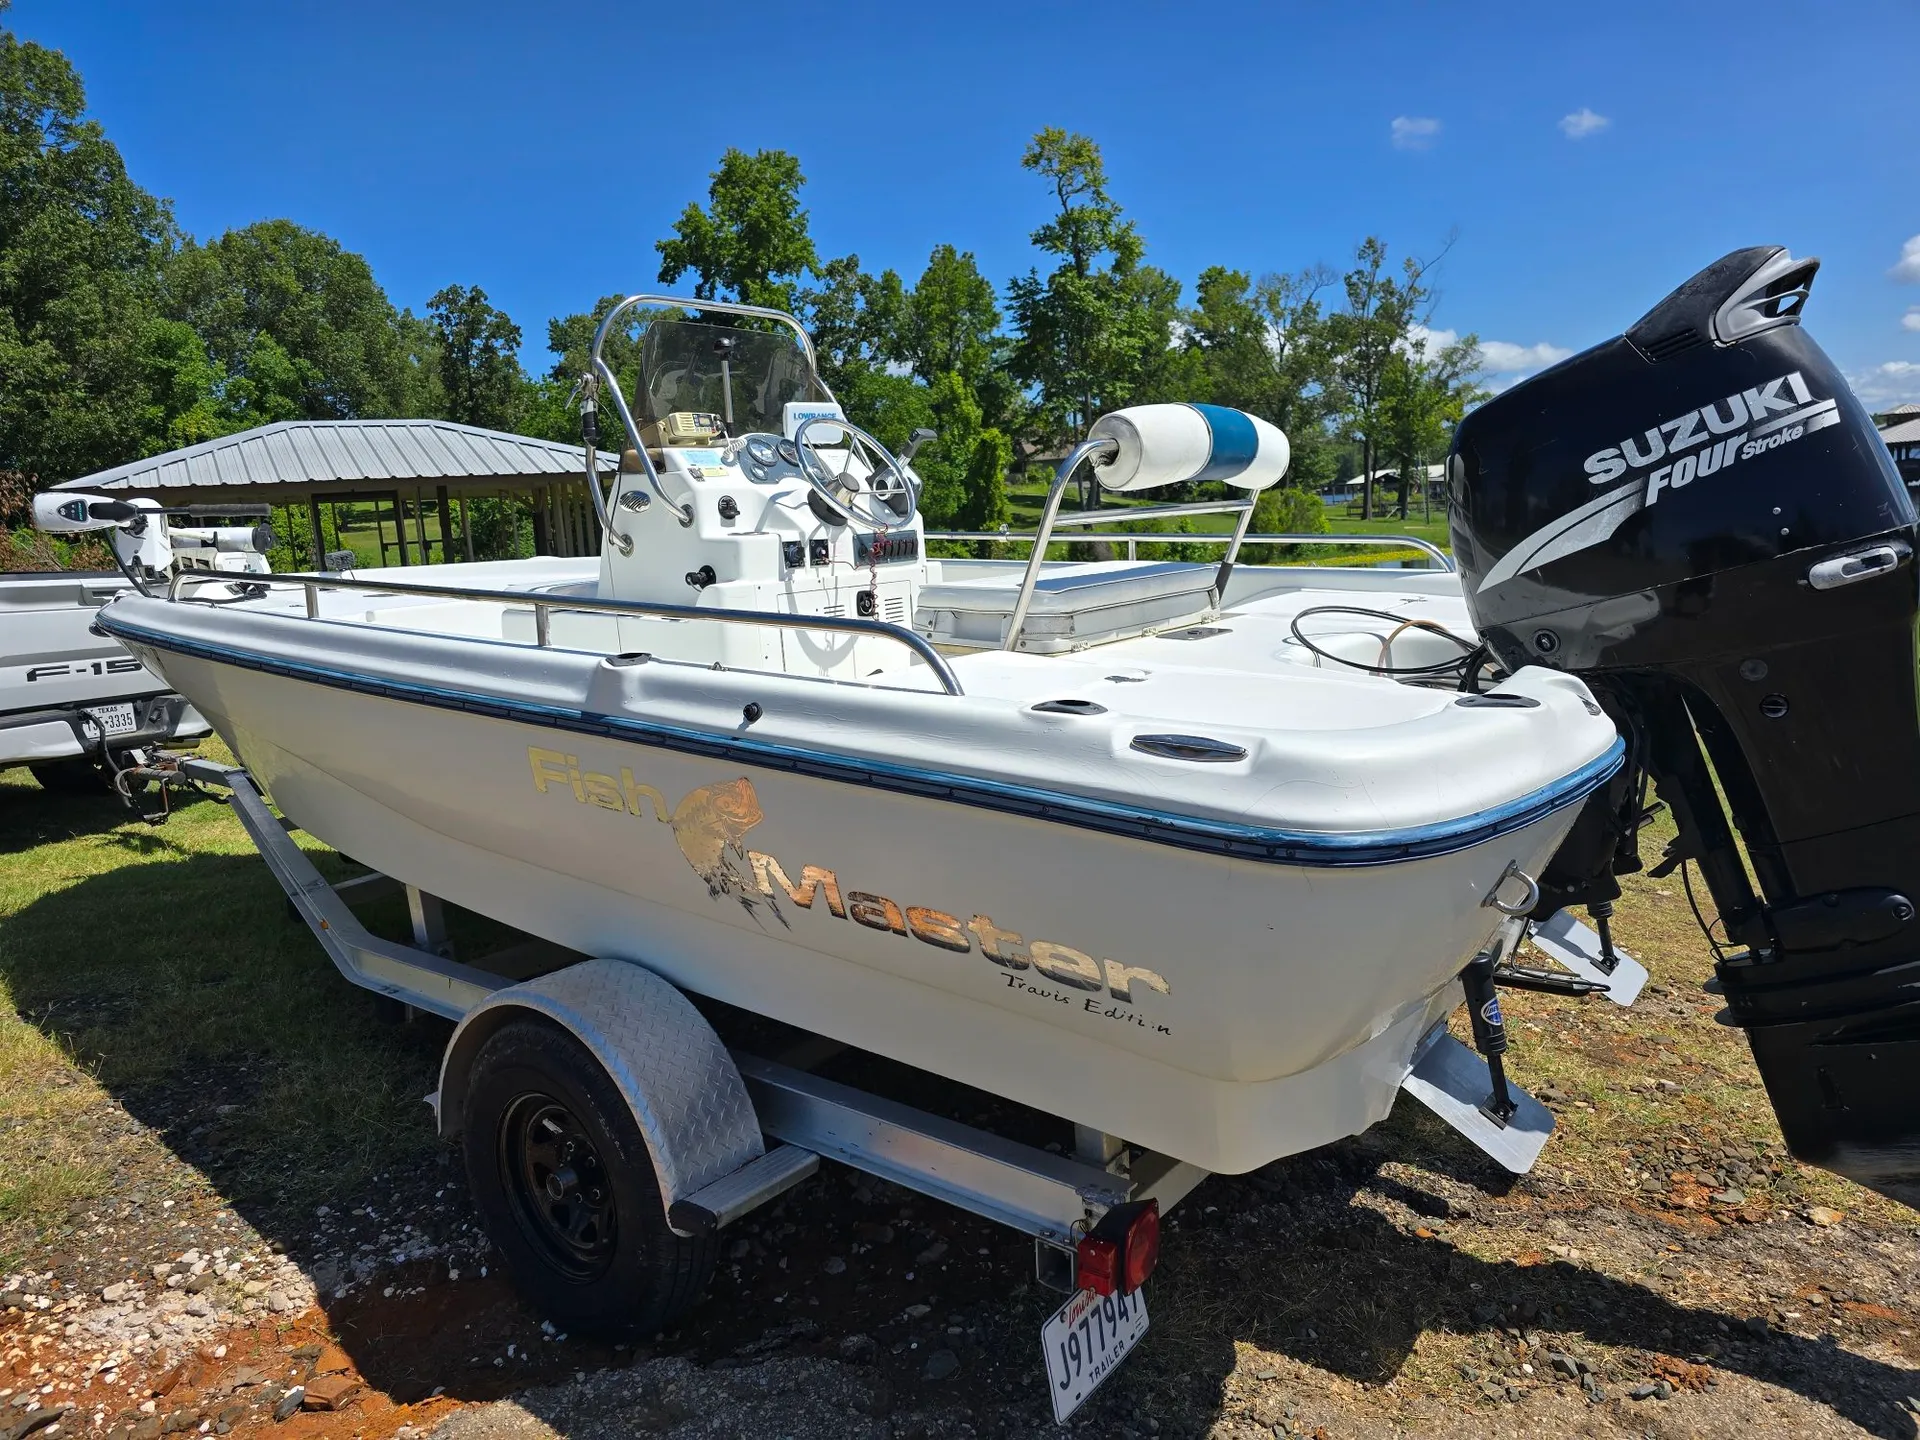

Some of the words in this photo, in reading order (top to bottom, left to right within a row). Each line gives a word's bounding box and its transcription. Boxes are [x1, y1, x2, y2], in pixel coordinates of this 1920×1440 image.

[793, 412, 837, 420] LOWRANCE
[1583, 371, 1812, 485] SUZUKI
[1741, 425, 1803, 460] Stroke
[26, 659, 142, 682] F-15
[98, 706, 118, 714] TEXAS
[527, 745, 672, 824] Fish
[747, 849, 1172, 1004] Master
[1001, 972, 1071, 1004] Travis
[1084, 998, 1172, 1036] Editin
[1089, 1340, 1125, 1384] TRAILER
